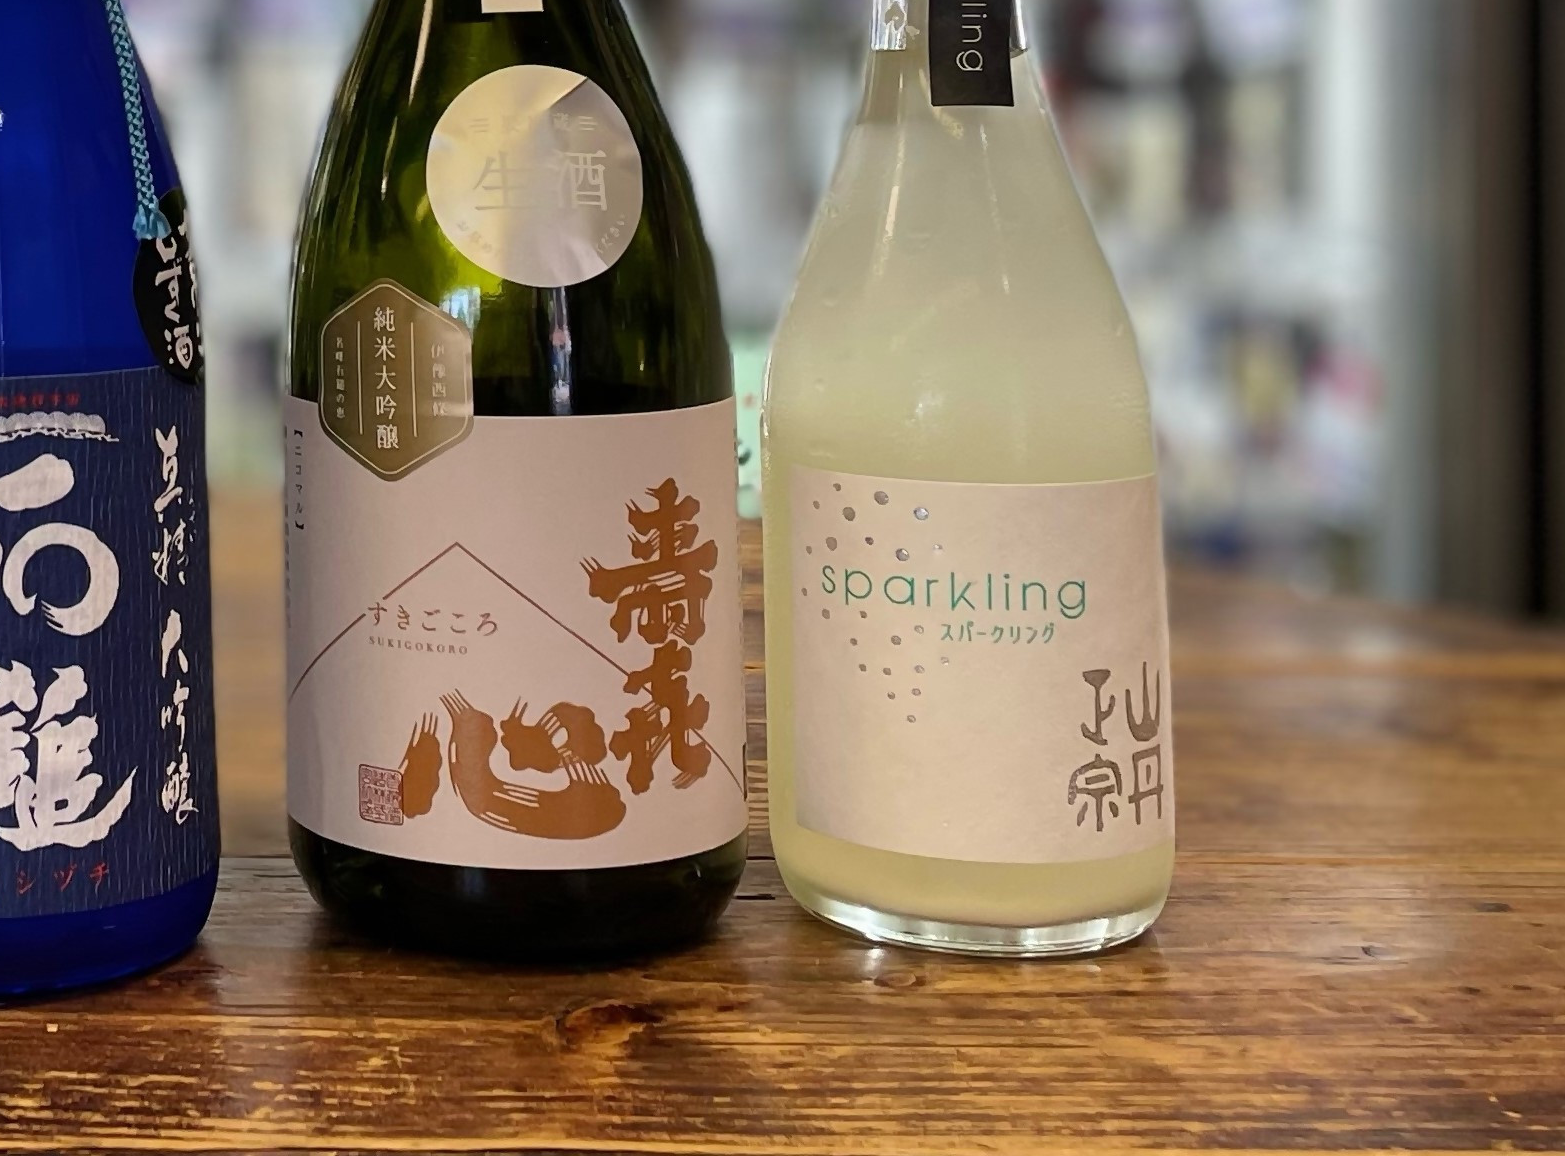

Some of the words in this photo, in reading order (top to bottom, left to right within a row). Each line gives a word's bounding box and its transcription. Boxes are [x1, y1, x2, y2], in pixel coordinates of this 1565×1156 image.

[472, 149, 608, 212] 生酒
[373, 306, 400, 450] 純米大吟醸
[820, 564, 1087, 620] sparkling
[367, 601, 499, 637] すきごころ
[939, 621, 1056, 645] スパークリング
[368, 635, 469, 656] SUKIGOKORO
